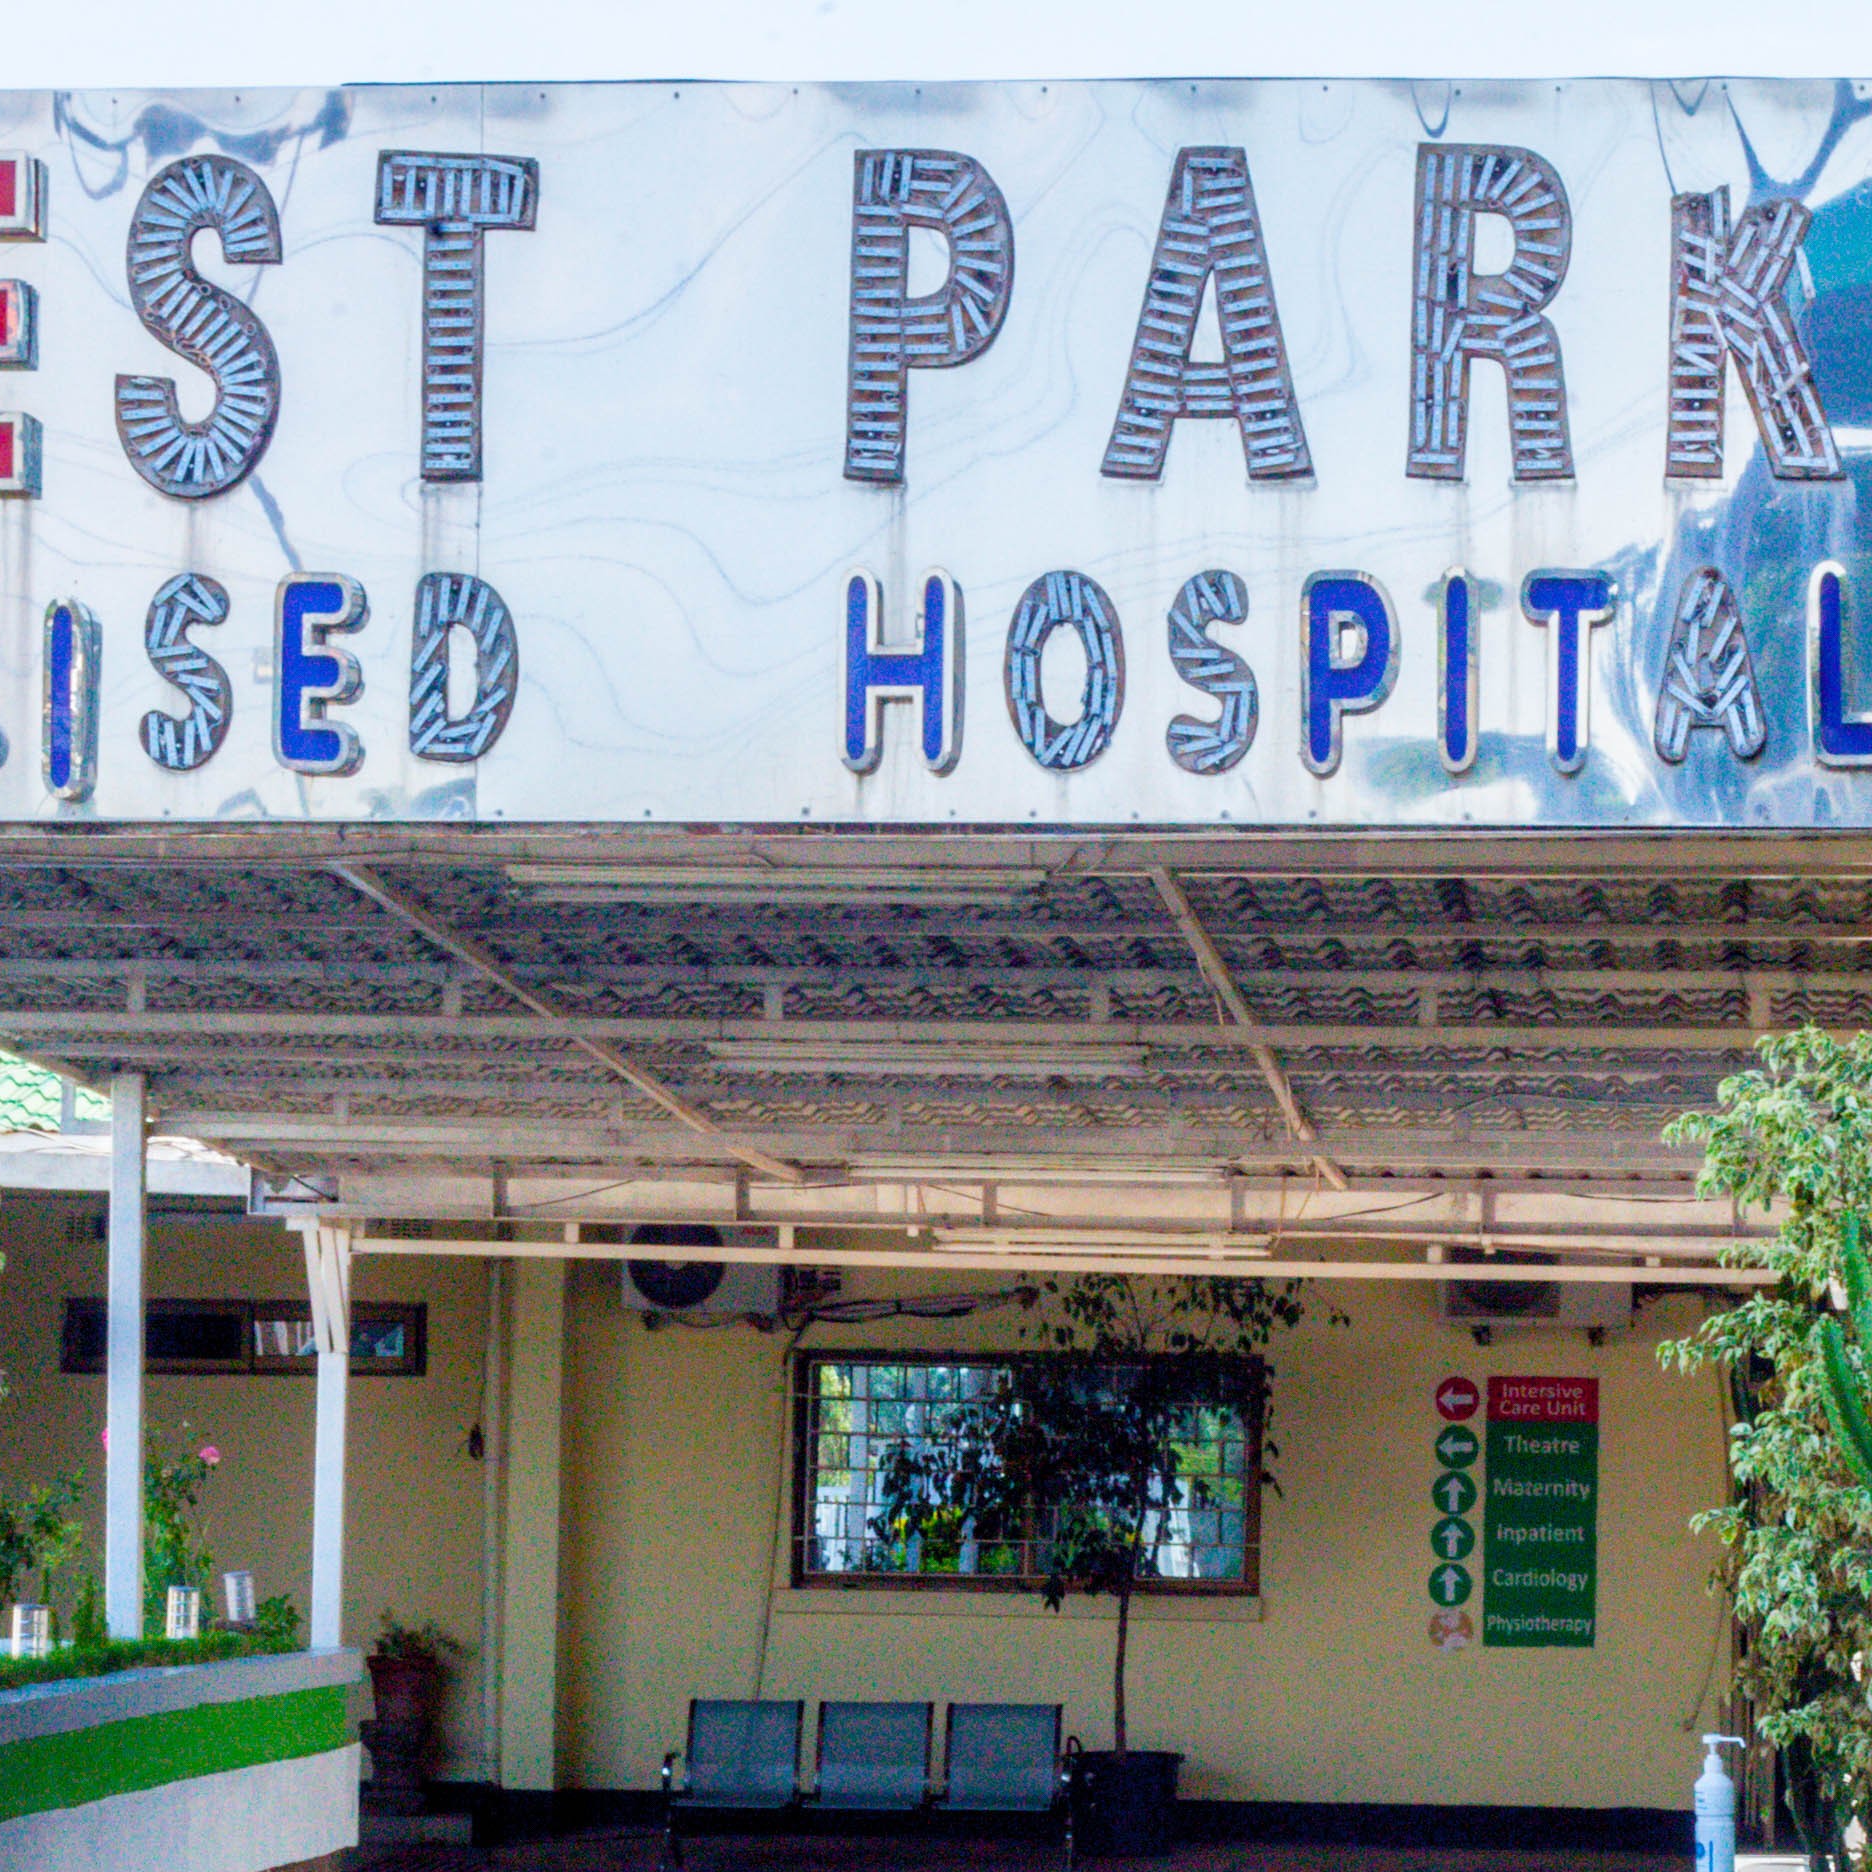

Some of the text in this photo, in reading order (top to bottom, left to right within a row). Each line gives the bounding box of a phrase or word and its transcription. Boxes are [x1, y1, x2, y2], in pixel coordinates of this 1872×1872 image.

[842, 142, 1847, 481] PARK
[1499, 1399, 1587, 1416] Care Unit
[1503, 1434, 1581, 1455] Theatre
[1492, 1478, 1591, 1501] Maternity
[1496, 1523, 1585, 1545] Inpatient
[1492, 1568, 1589, 1592] Cardiology
[1486, 1614, 1593, 1636] Physiotherapy
